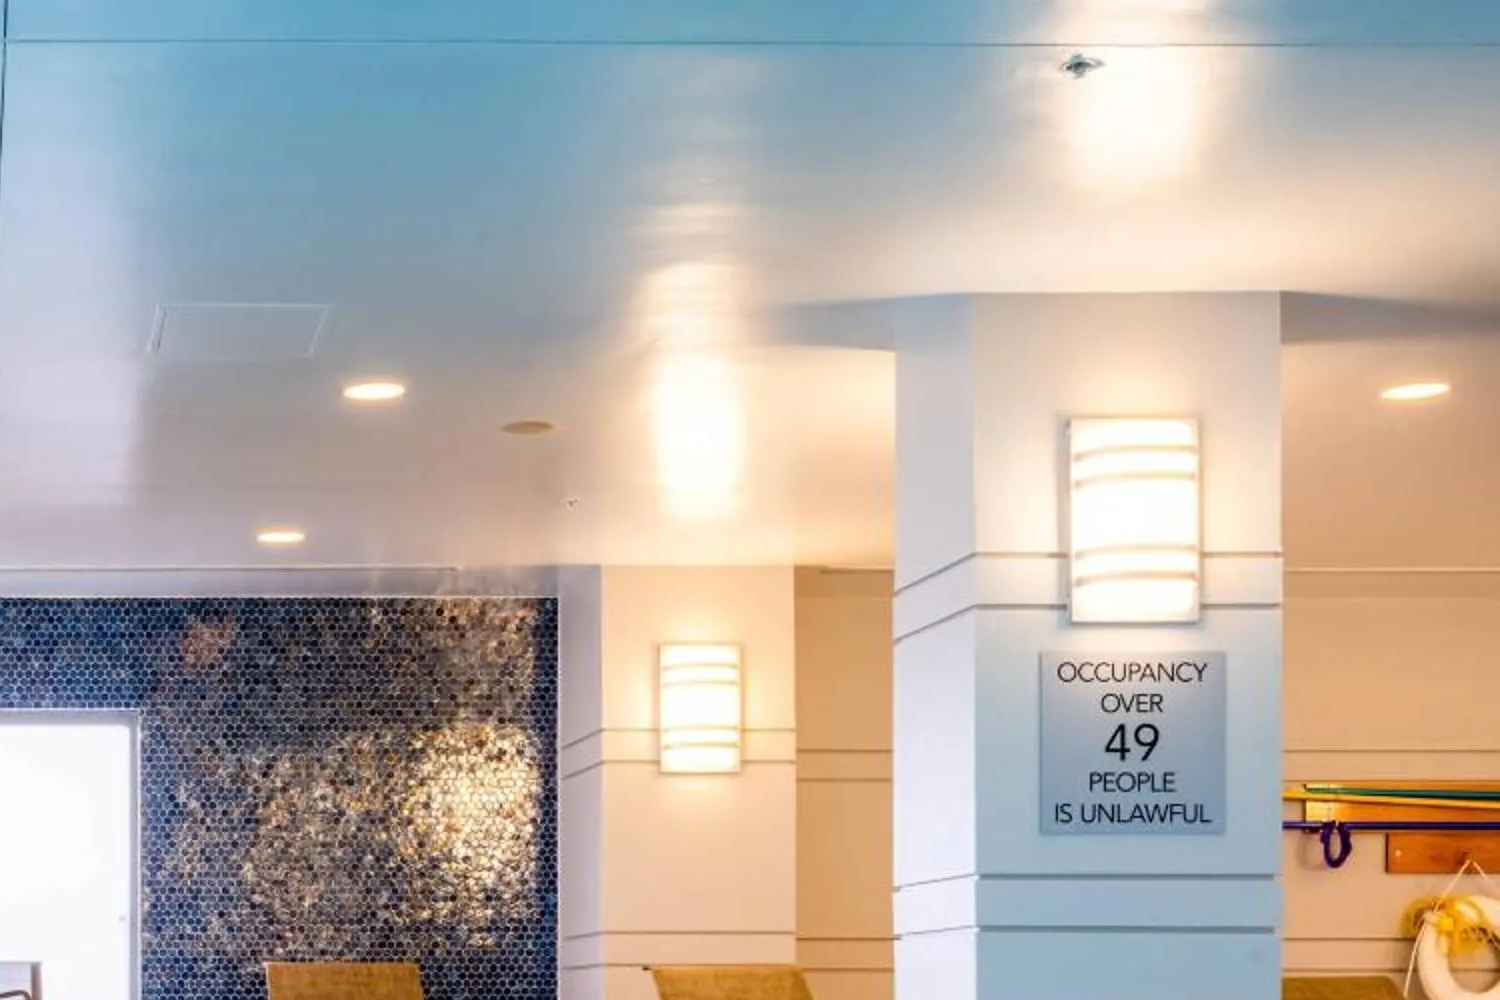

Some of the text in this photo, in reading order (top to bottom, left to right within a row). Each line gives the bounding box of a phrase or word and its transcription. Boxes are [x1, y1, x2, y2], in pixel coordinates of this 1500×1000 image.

[1057, 661, 1208, 683] OCCUPANCY
[1101, 693, 1163, 713] OVER
[1105, 723, 1160, 762] 49
[1089, 771, 1176, 793] PEOPLE
[1055, 803, 1213, 824] IS UNLAWFUL
